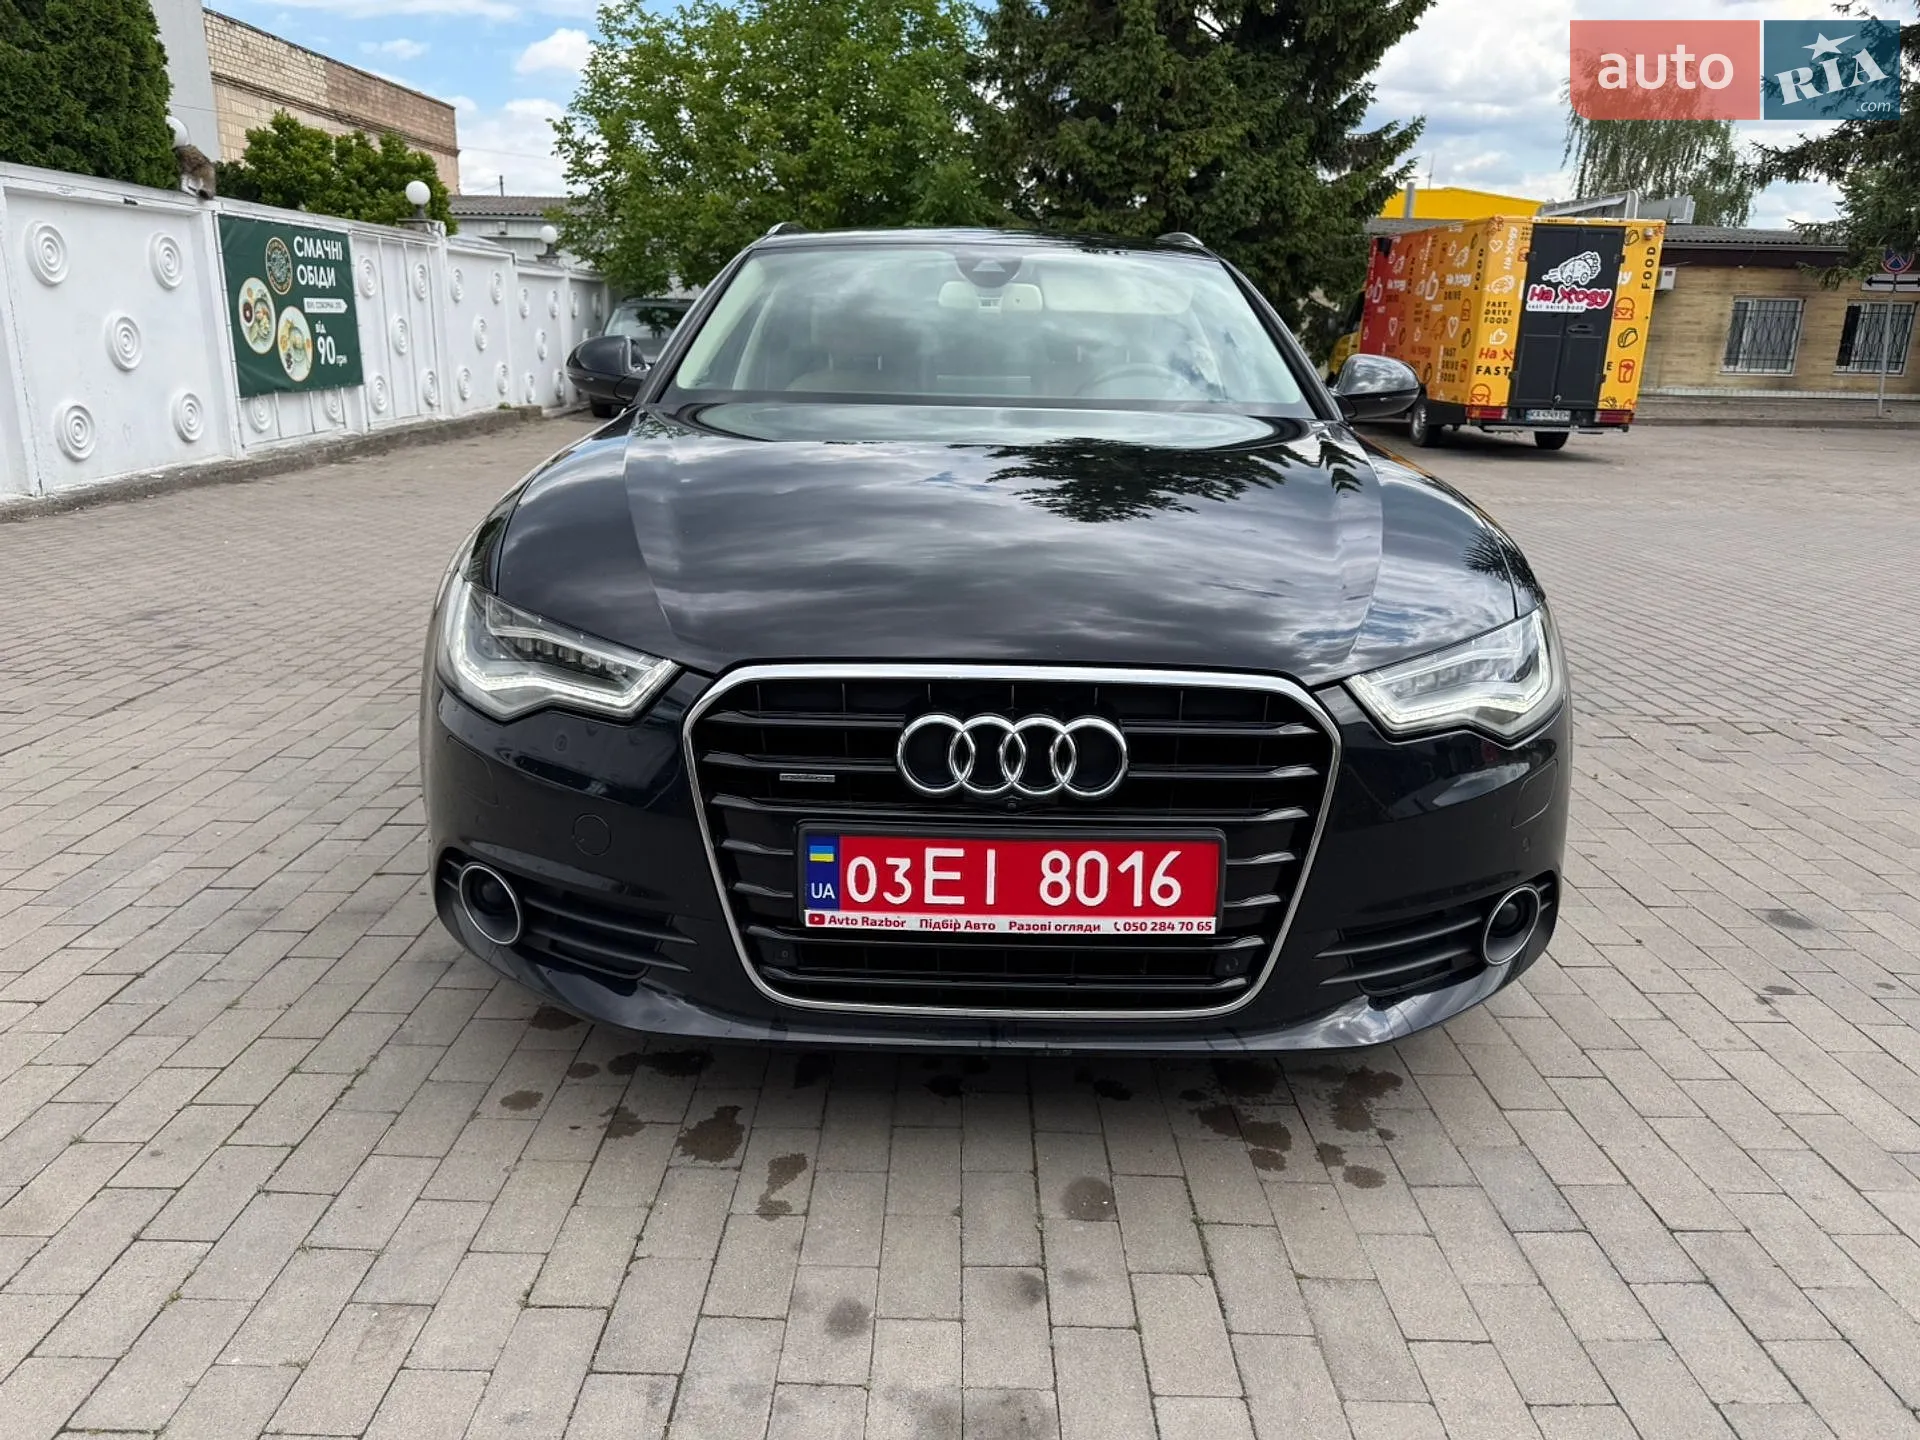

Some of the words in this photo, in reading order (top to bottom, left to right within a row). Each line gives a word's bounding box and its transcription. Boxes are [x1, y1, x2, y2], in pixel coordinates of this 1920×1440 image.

[294, 235, 343, 261] СМАЧНІ
[297, 264, 336, 289] ОБІДИ
[1642, 247, 1656, 290] FOOD
[317, 335, 336, 365] 90
[1476, 366, 1510, 376] FAST
[1039, 849, 1182, 907] 8016
[811, 882, 835, 899] UA
[828, 915, 858, 926] Avto
[861, 916, 907, 928] Razbor
[919, 918, 960, 931] Підбір
[964, 920, 996, 931] Авто
[1008, 920, 1051, 931] Разові
[1054, 923, 1101, 933] огляди
[1123, 921, 1148, 931] 050
[1150, 921, 1175, 931] 284
[1179, 921, 1194, 931] 70
[1197, 921, 1212, 931] 65
